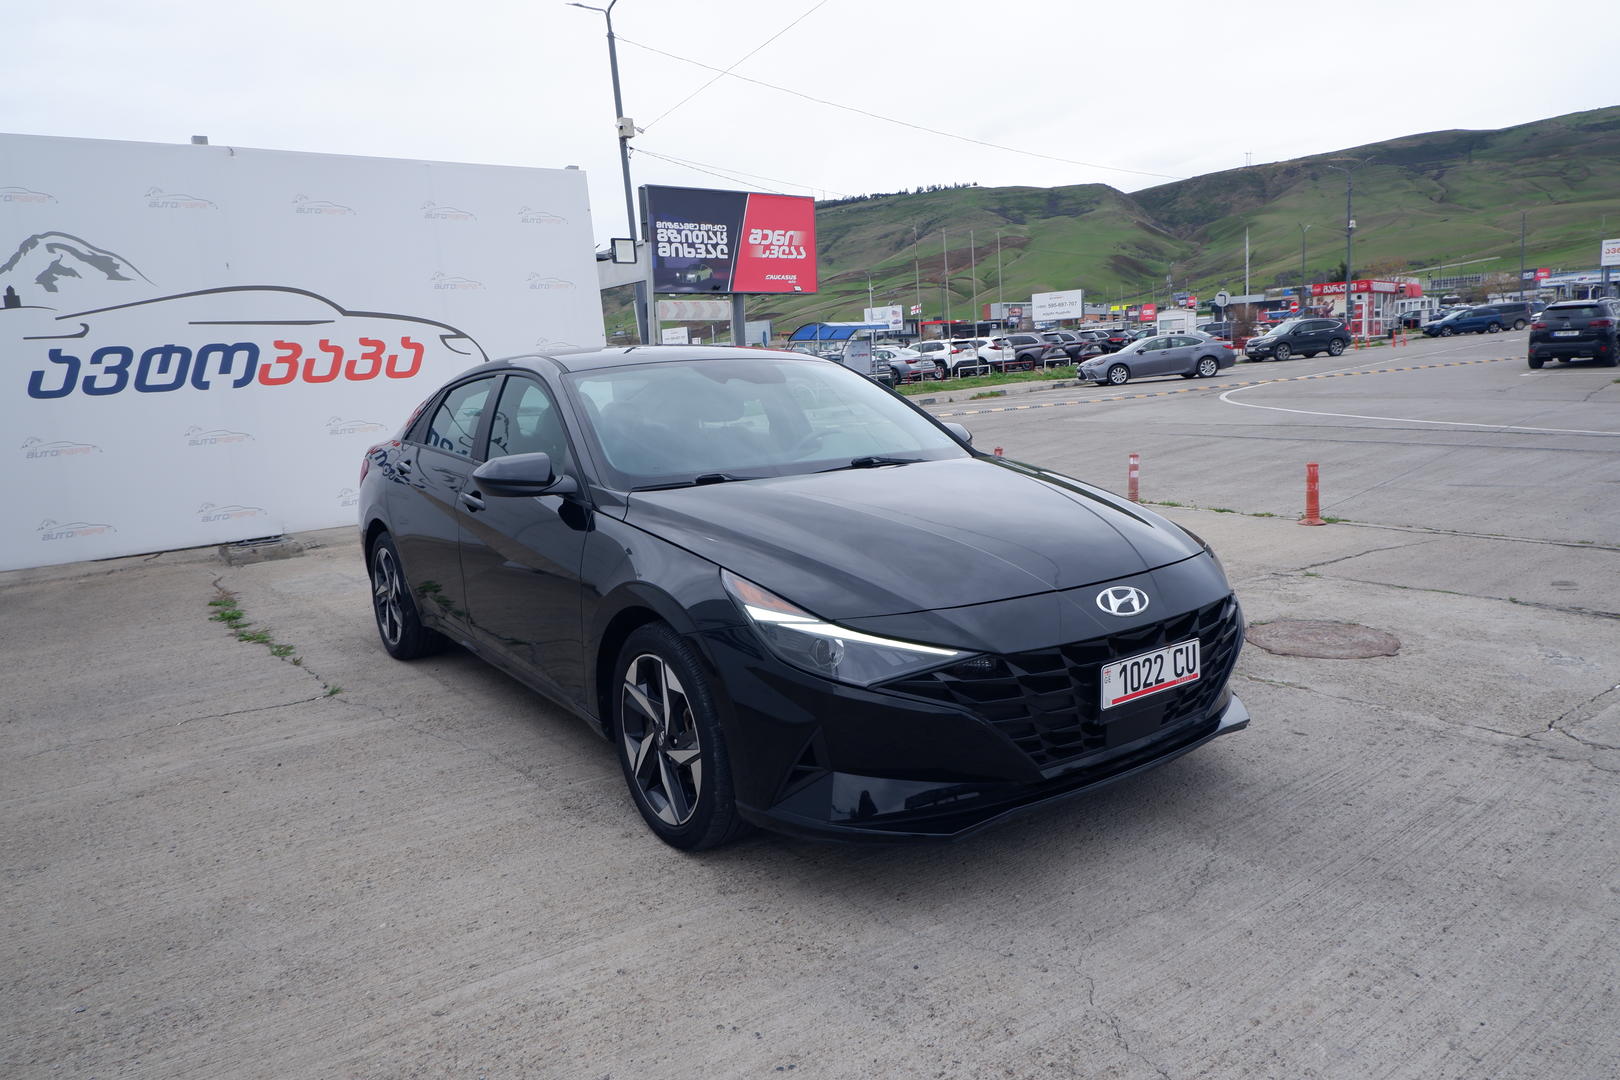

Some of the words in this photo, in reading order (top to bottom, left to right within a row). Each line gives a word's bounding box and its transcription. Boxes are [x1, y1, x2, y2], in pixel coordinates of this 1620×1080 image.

[27, 335, 425, 399] ავტოპაპა
[1119, 653, 1165, 695] 1022
[1173, 643, 1197, 678] CU
